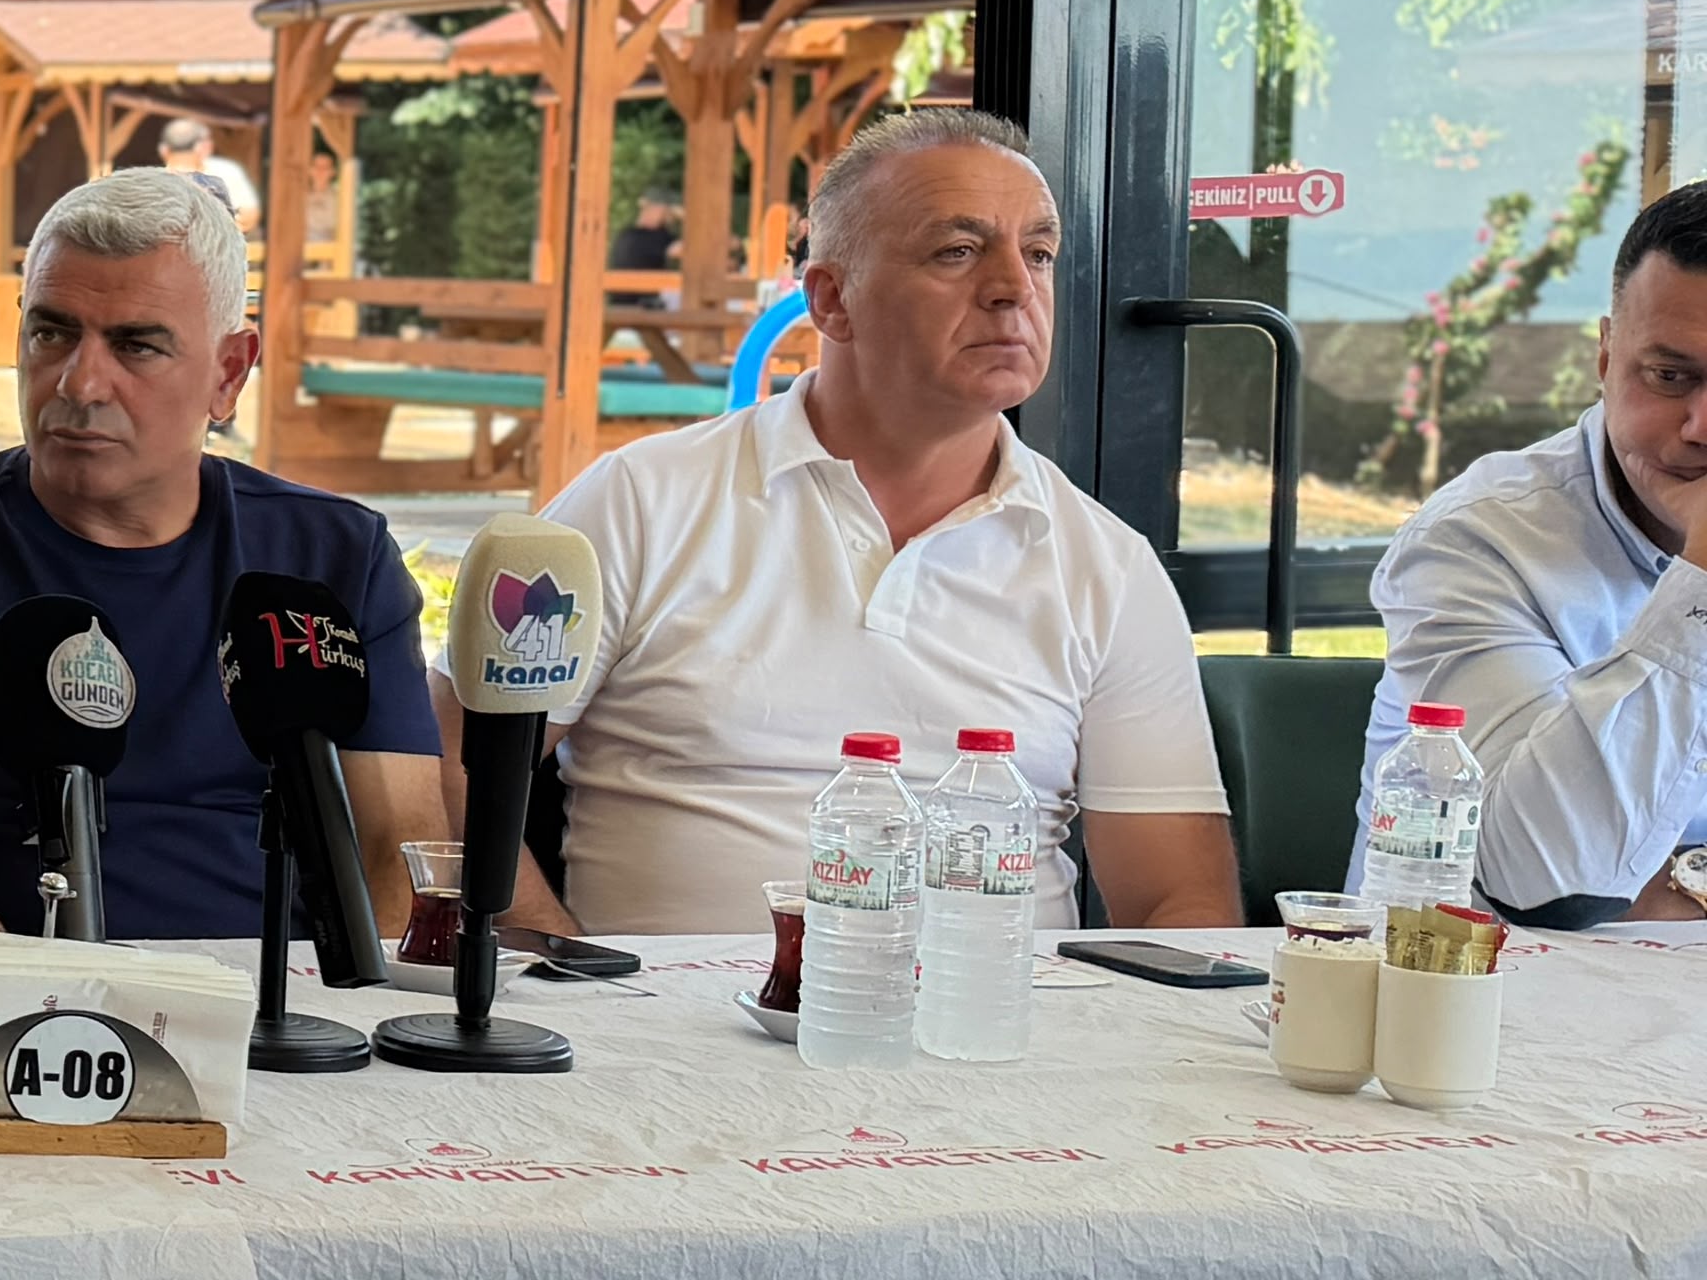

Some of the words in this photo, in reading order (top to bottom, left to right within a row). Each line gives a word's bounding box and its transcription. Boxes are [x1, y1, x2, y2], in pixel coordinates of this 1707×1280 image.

[1256, 186, 1296, 205] PULL
[504, 614, 565, 662] 41
[484, 656, 580, 684] kanal
[811, 860, 875, 886] KIZILAY
[998, 851, 1036, 873] KIZIL
[9, 1048, 126, 1100] A-08
